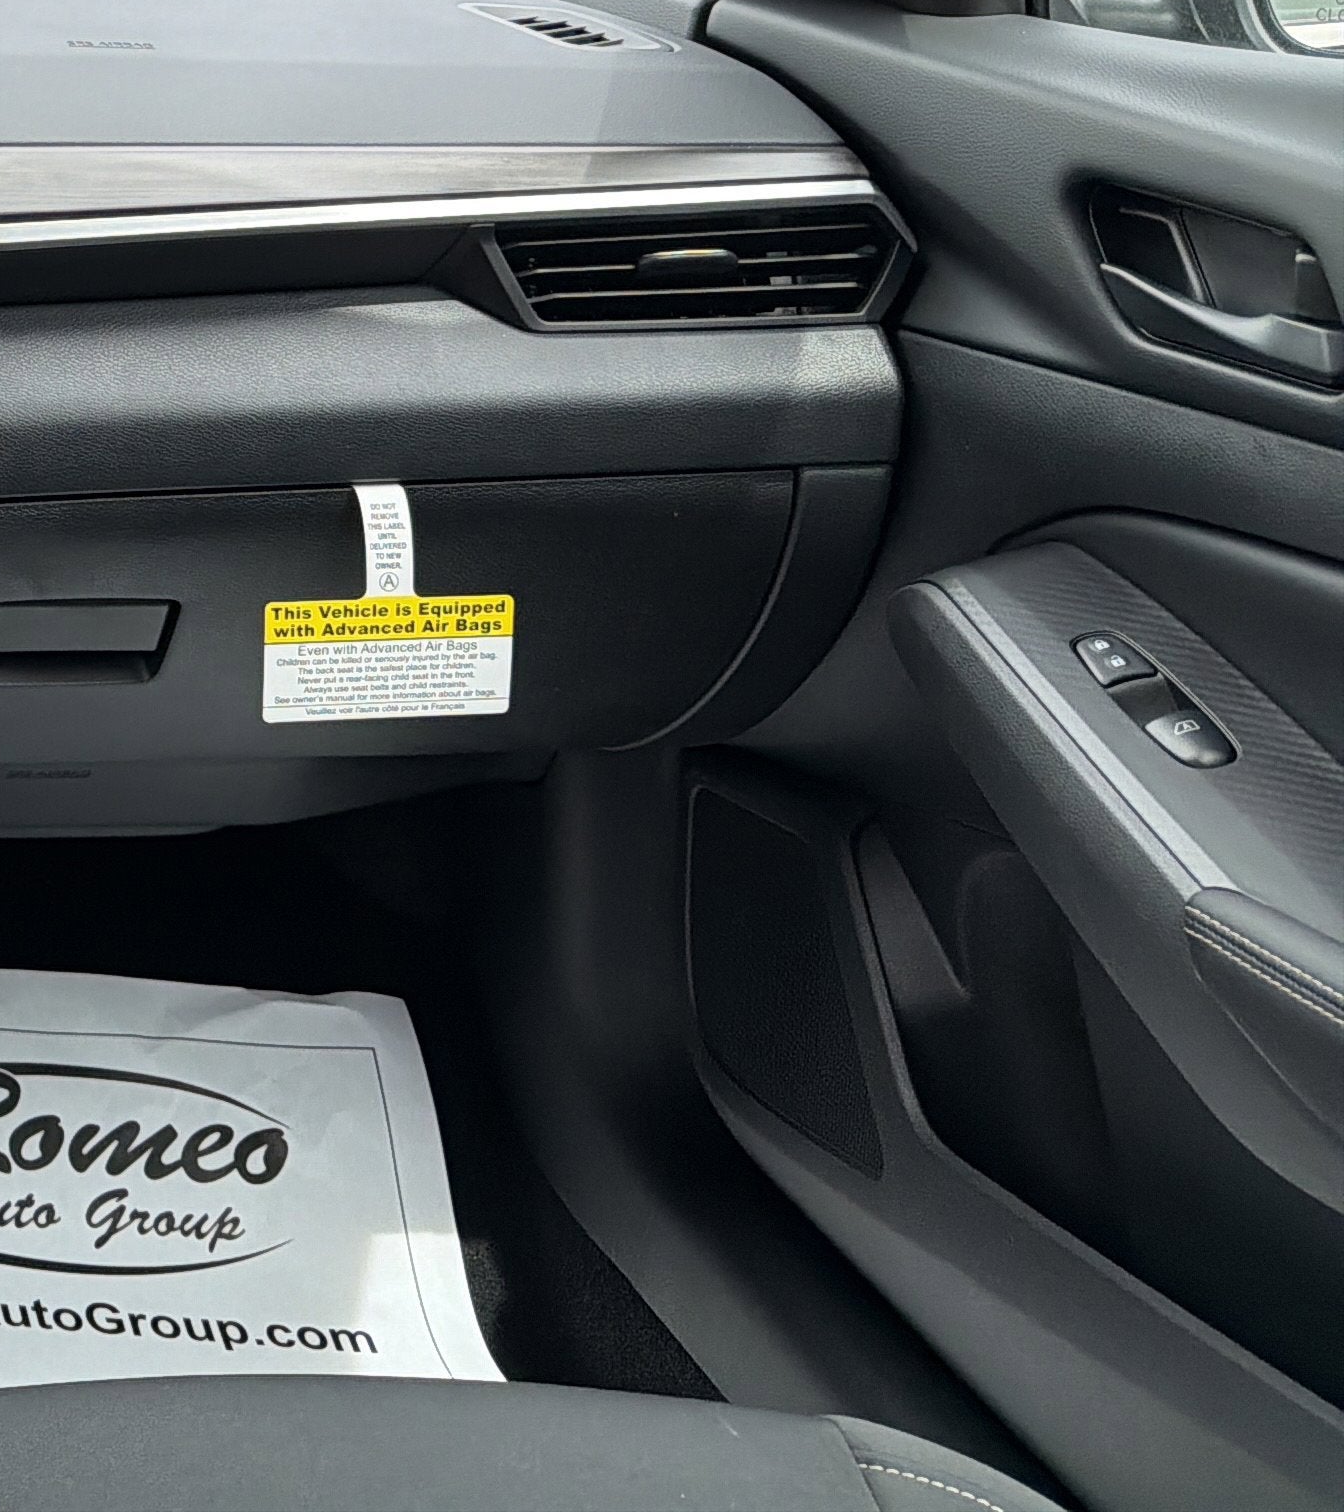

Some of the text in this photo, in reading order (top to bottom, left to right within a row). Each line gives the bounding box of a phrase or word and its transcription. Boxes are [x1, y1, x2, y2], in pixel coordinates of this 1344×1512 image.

[384, 522, 406, 530] LABEL
[370, 542, 407, 550] DELIVERED
[271, 600, 506, 620] This Vehicle is Equipped
[274, 619, 502, 637] with Advanced Air Bags
[298, 640, 477, 656] Even with Advanced Air Bags
[85, 1187, 245, 1253] Group
